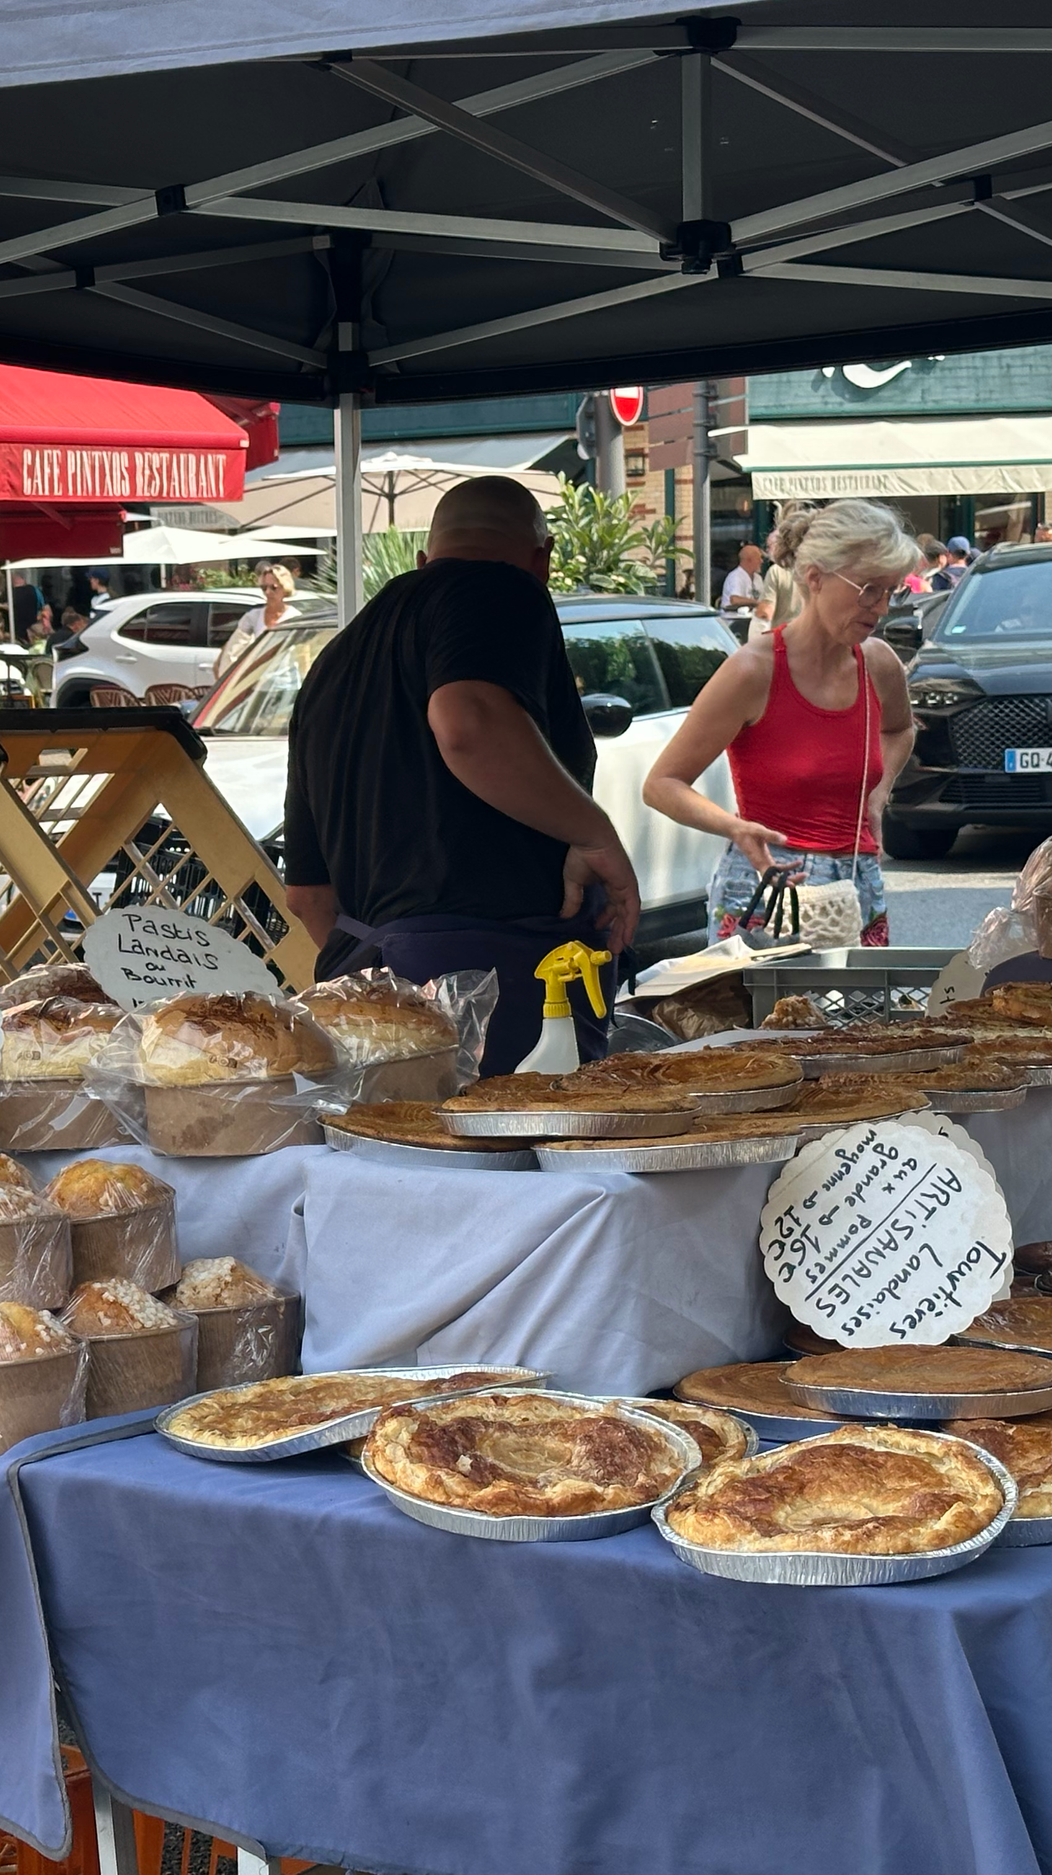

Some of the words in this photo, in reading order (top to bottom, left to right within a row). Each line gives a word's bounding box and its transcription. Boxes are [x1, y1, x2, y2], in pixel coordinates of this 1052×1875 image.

[23, 449, 63, 496] CAFE
[67, 450, 131, 497] PINTXOS
[134, 451, 227, 498] RESTAURANT
[121, 913, 211, 947] Pastis
[117, 933, 219, 971] Landais
[120, 967, 198, 989] Bourrit
[822, 1129, 877, 1191] moyenne
[844, 1142, 899, 1206] grande
[882, 1157, 918, 1194] aux
[841, 1243, 943, 1336] Landaises
